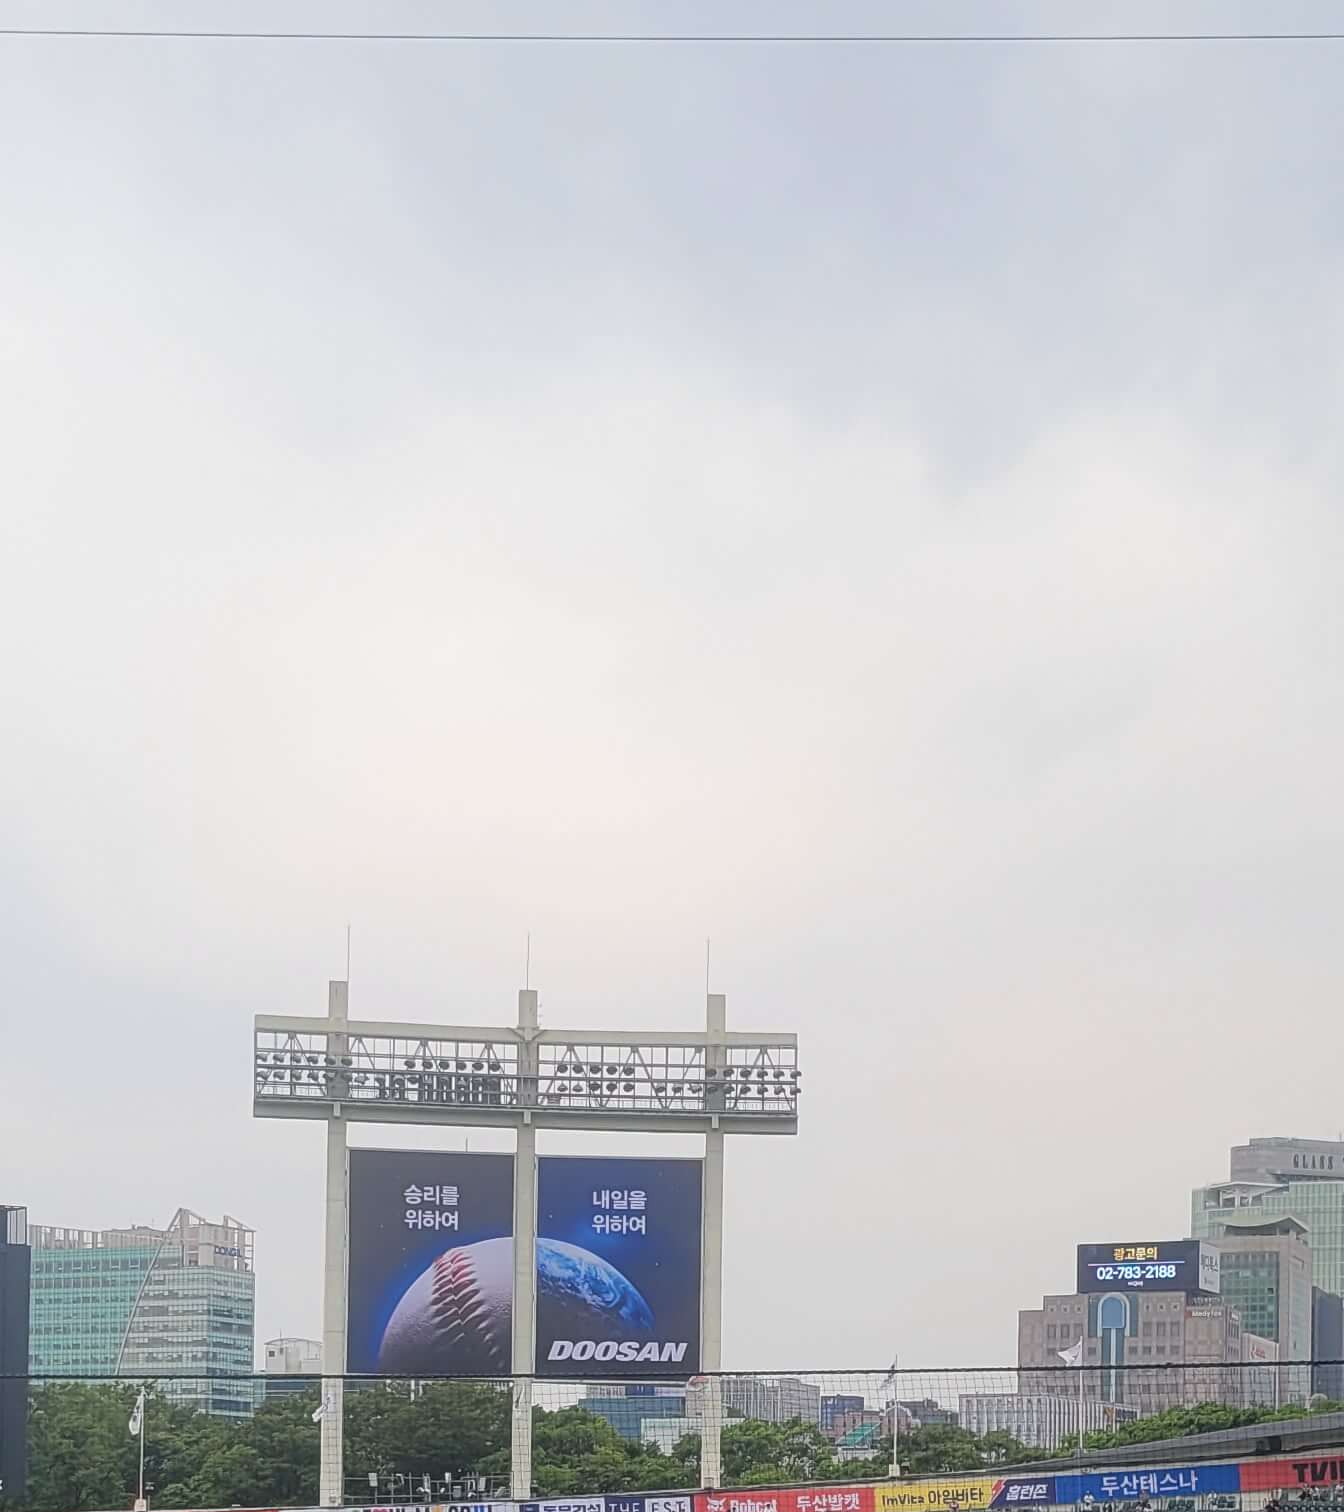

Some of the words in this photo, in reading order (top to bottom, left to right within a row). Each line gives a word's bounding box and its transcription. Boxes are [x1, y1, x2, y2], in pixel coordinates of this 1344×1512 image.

[1293, 1153, 1334, 1170] GLASS
[403, 1183, 460, 1206] 승리를
[592, 1189, 648, 1211] 내일을
[403, 1209, 460, 1231] 위하여
[592, 1214, 648, 1236] 위하여
[1113, 1246, 1159, 1262] 광고문의
[1096, 1264, 1176, 1281] 02-783-2188
[547, 1340, 688, 1362] DOOSAN
[1100, 1469, 1199, 1499] 두산테스나
